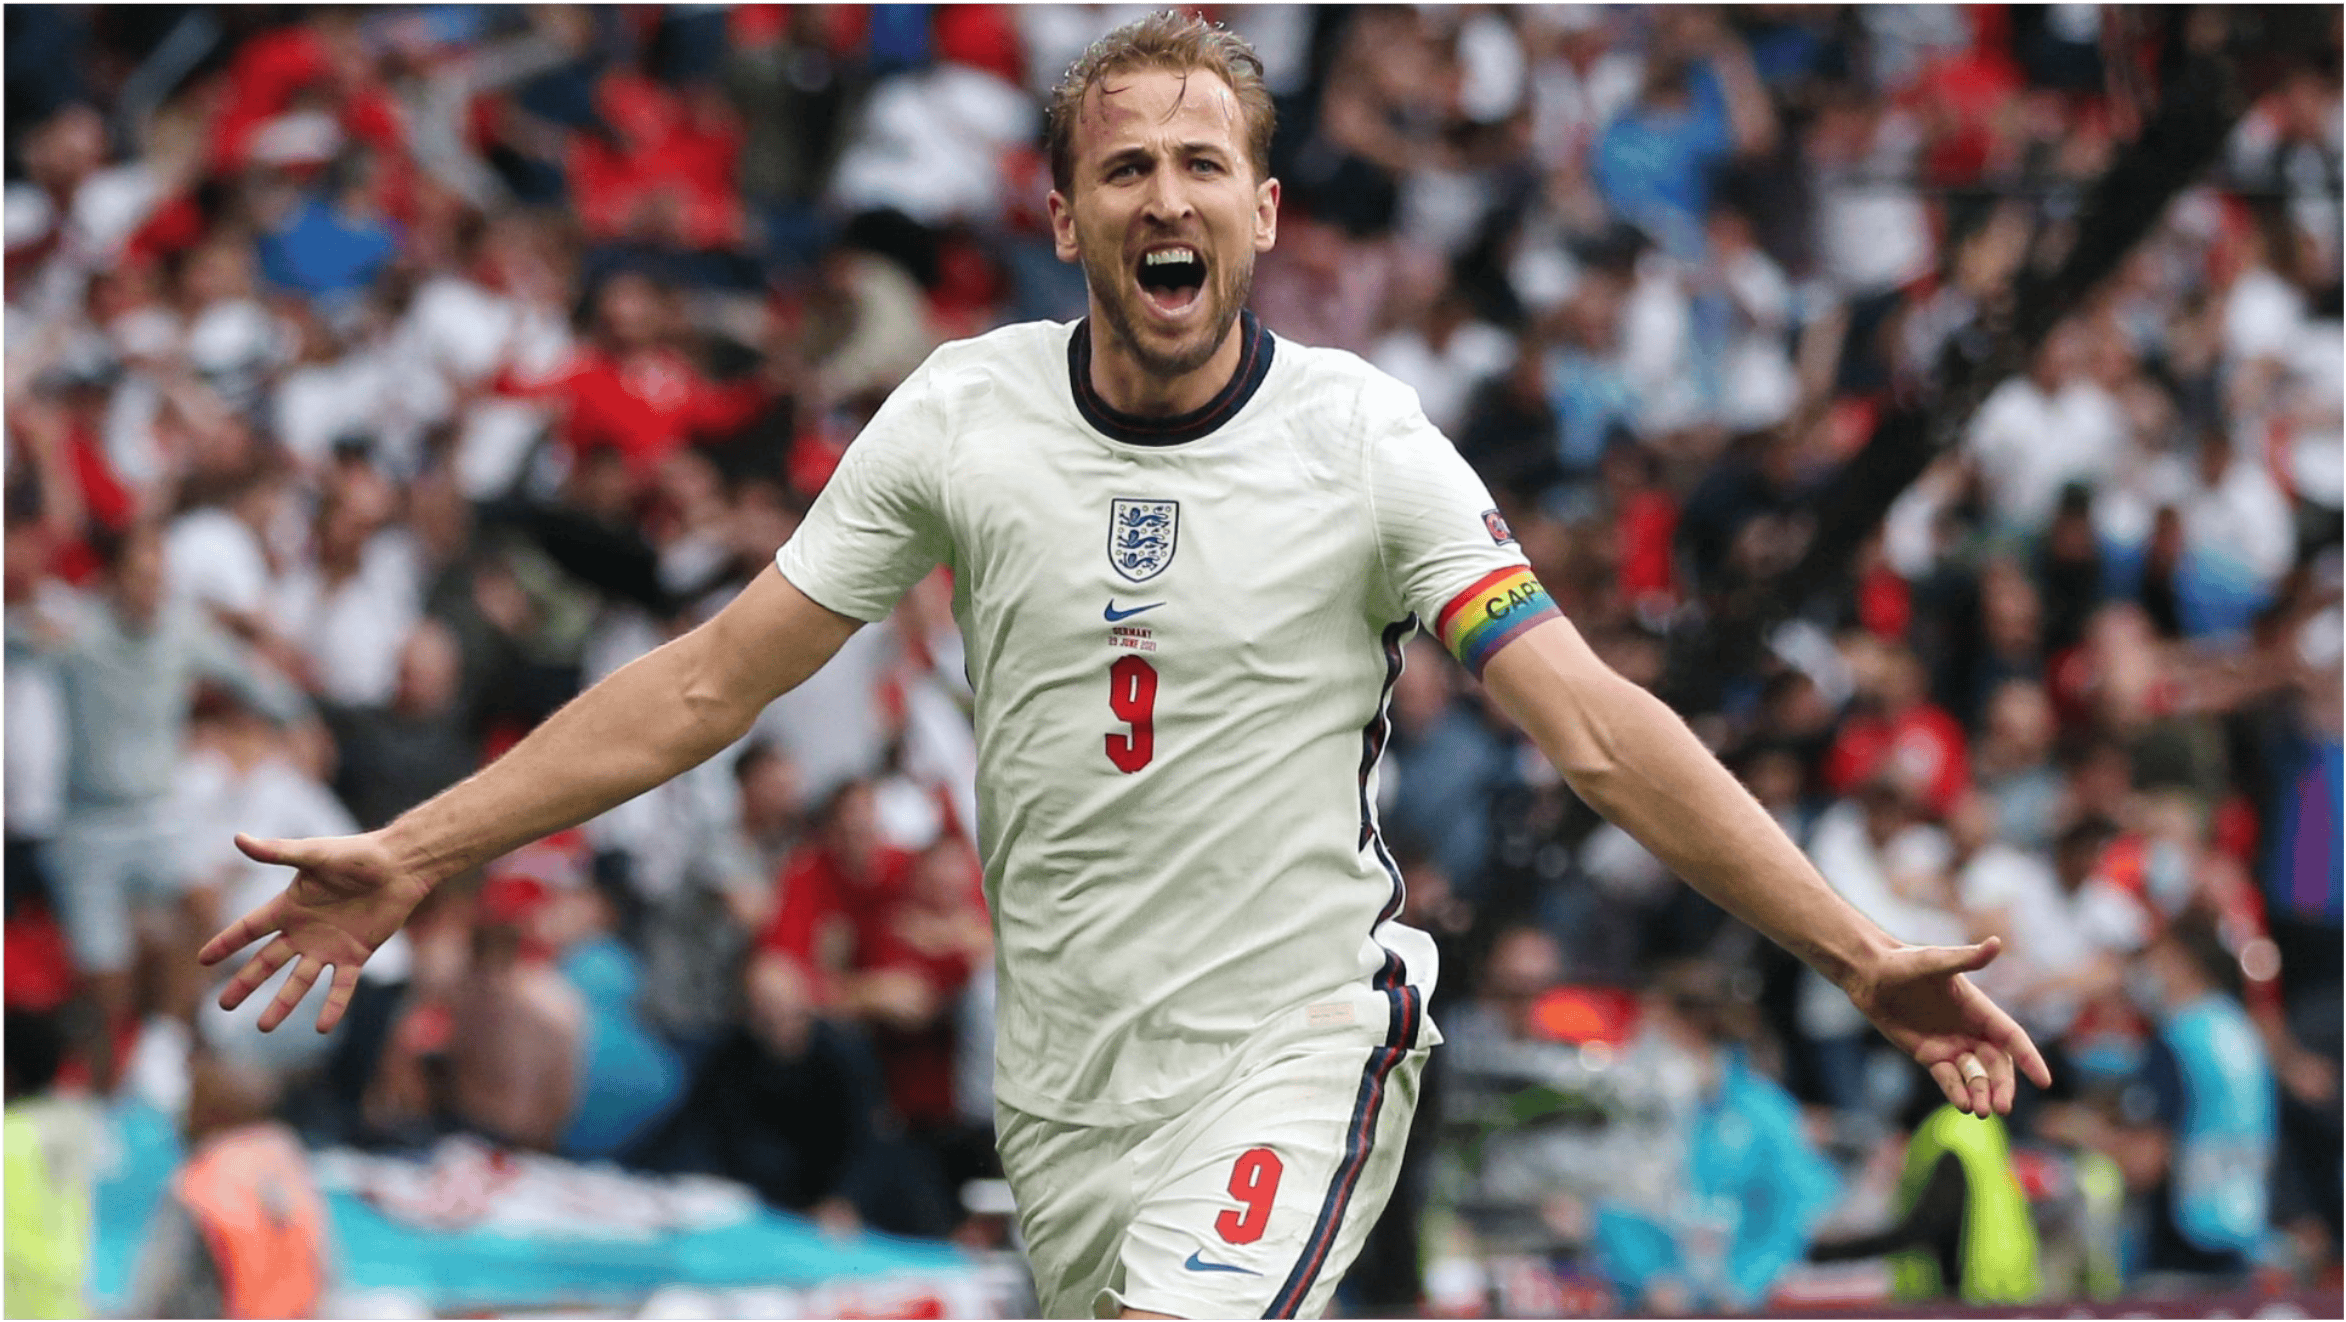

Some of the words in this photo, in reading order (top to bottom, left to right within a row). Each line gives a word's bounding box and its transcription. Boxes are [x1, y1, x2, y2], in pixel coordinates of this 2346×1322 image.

[1112, 627, 1152, 639] GERMANY
[1119, 638, 1139, 649] JUNE
[1105, 654, 1158, 774] 9
[1214, 1148, 1284, 1245] 9
